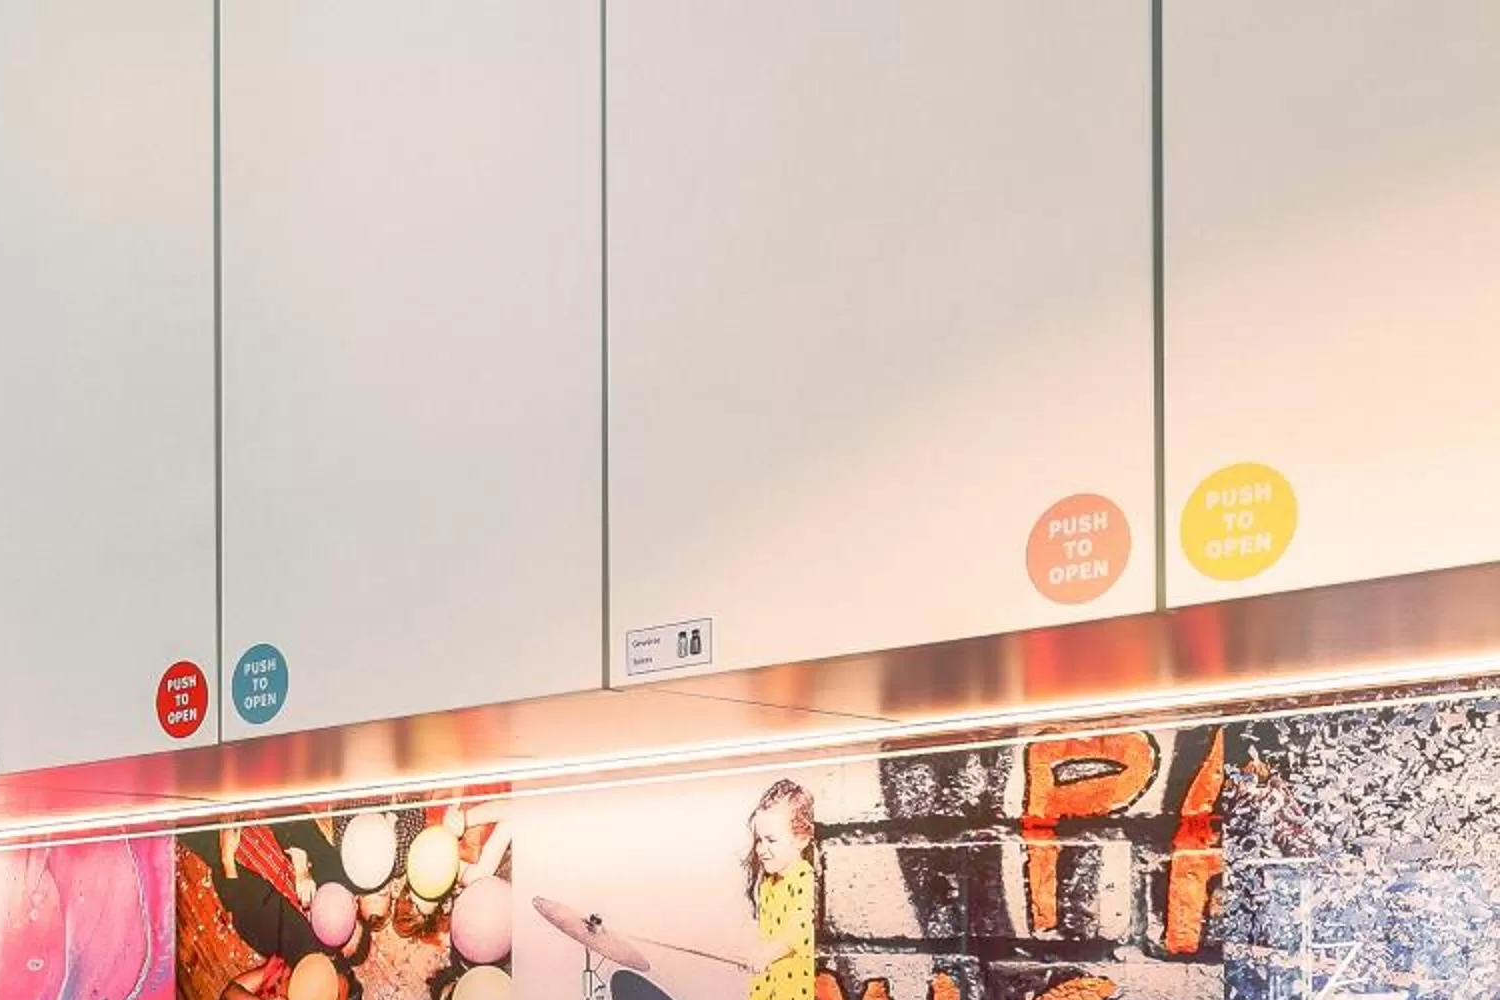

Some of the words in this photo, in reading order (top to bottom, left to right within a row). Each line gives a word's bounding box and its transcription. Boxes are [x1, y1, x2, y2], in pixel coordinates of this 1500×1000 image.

[1205, 482, 1273, 510] PUSH
[1049, 511, 1109, 538] PUSH
[1223, 510, 1254, 533] TO
[1063, 538, 1093, 560] TO
[1204, 533, 1273, 560] OPEN
[1048, 560, 1109, 585] OPEN
[243, 658, 277, 676] PUSH
[167, 674, 197, 692] PUSH
[251, 677, 269, 692] TO
[174, 692, 189, 707] TO
[243, 692, 277, 710] OPEN
[167, 707, 198, 725] OPEN
